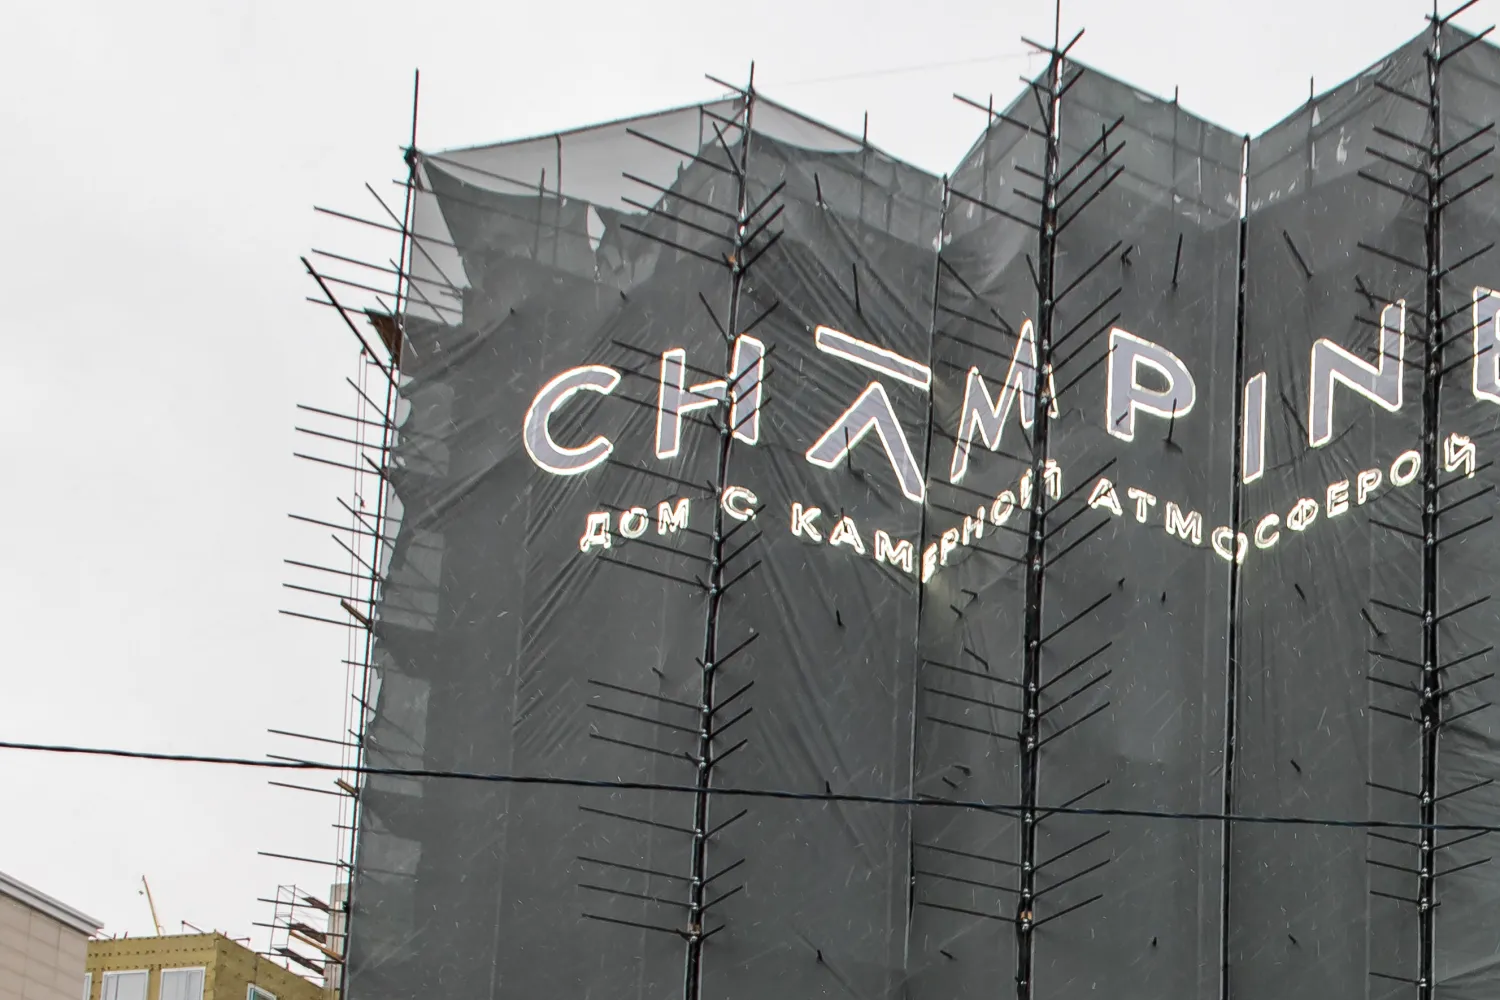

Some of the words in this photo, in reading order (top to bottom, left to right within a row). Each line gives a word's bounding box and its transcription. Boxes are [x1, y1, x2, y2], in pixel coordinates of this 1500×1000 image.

[579, 497, 690, 553] ДОМ
[720, 485, 758, 521] С
[790, 458, 1063, 584] КАМЕРНОЙ
[1087, 432, 1477, 565] АТМОСФЕРОЙ
